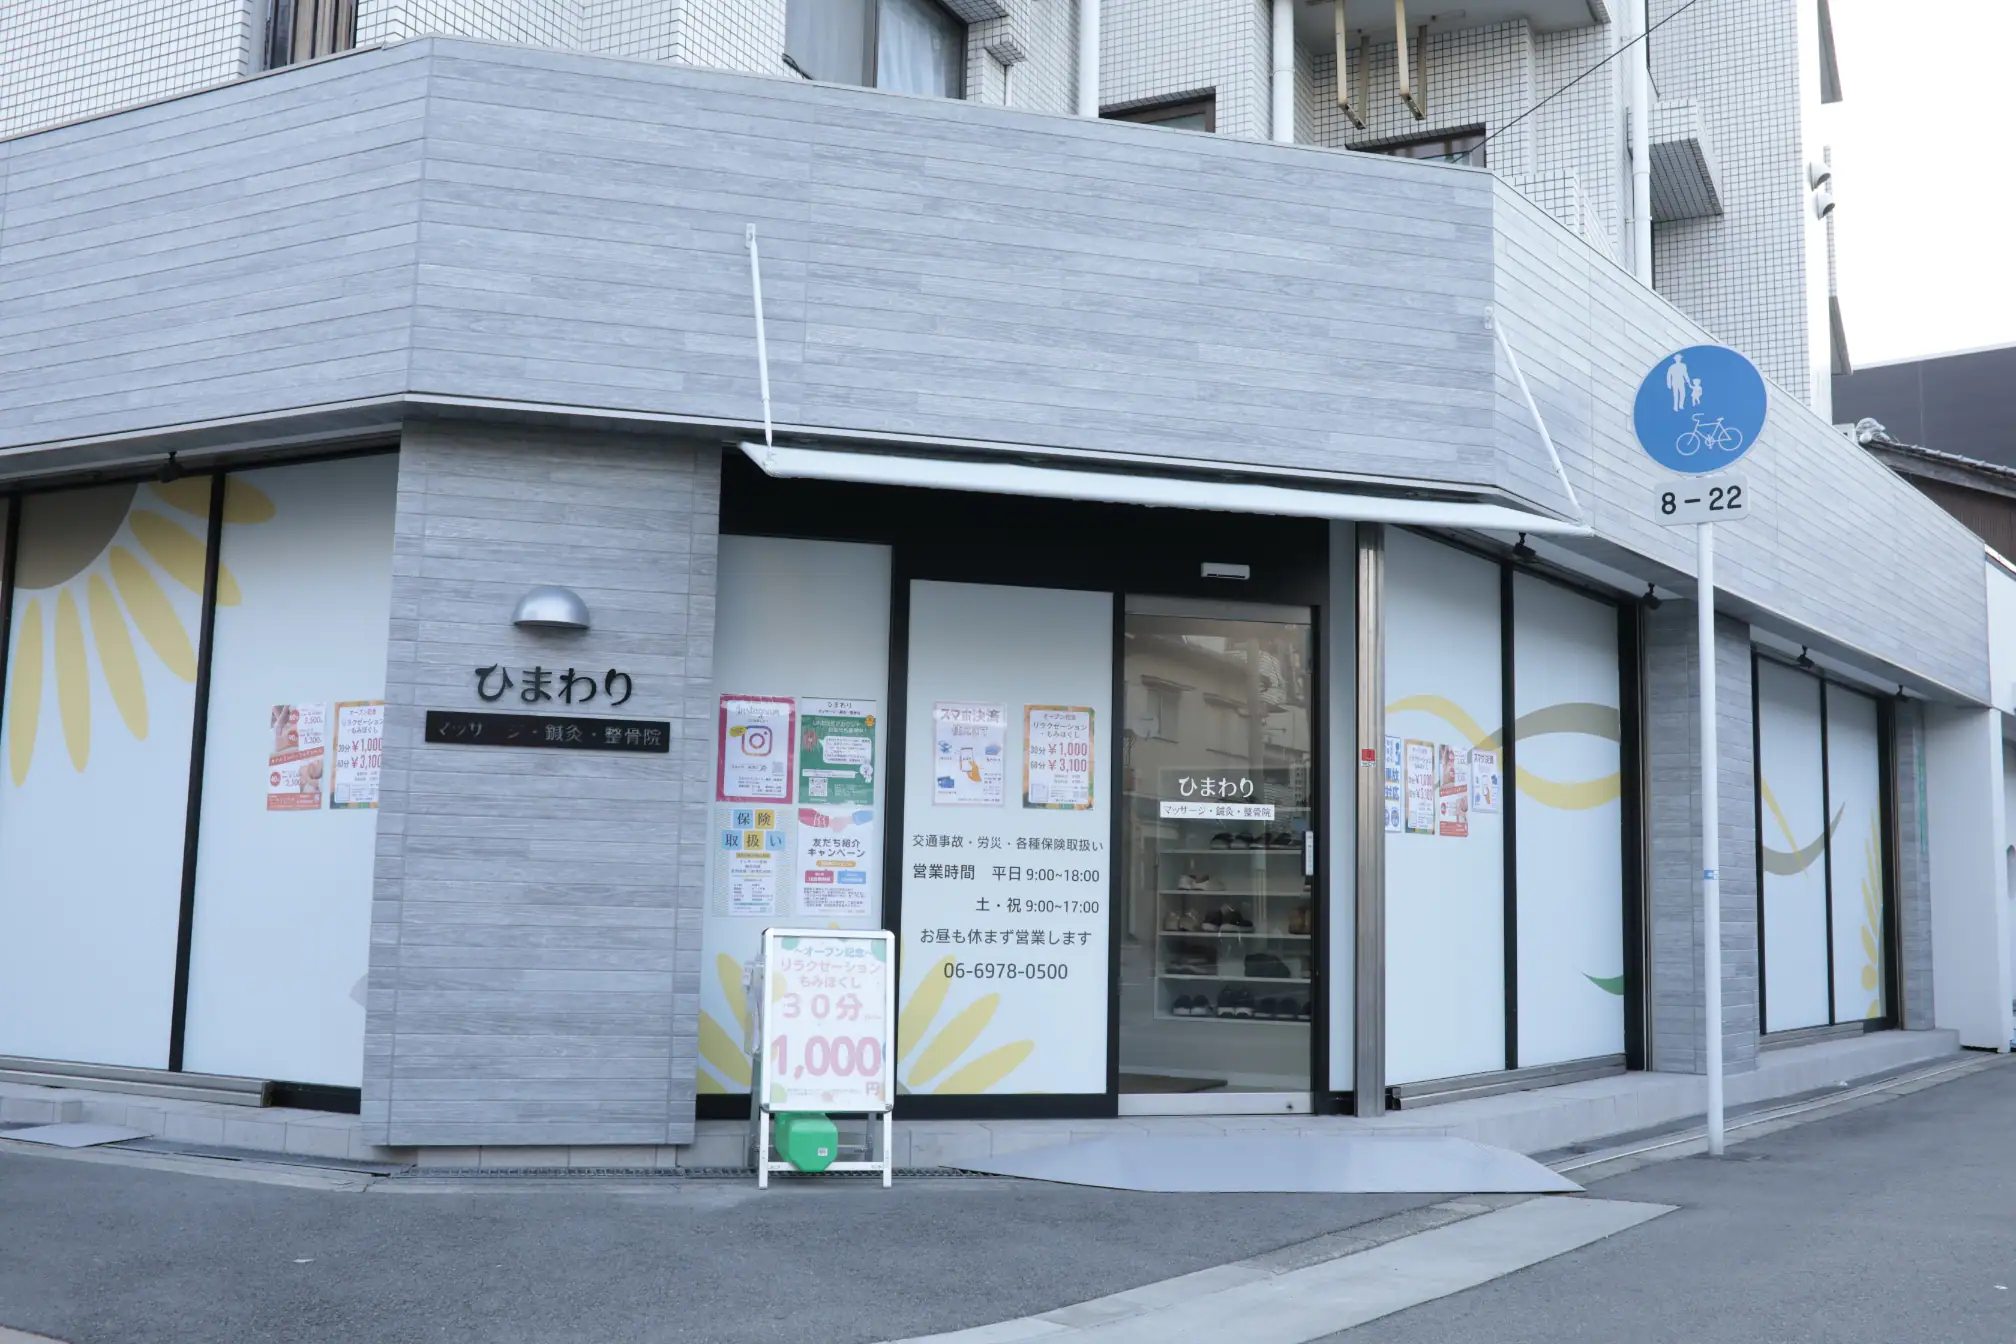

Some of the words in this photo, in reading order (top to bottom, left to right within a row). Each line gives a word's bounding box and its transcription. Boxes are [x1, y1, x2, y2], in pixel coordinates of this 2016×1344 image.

[475, 663, 633, 706] ひまわり
[438, 721, 661, 746] マッサジ・鍼灸・整骨院
[1178, 776, 1254, 798] ひまわり
[737, 812, 771, 826] 保険
[1164, 805, 1272, 818] マッサージ・鍼灸・整骨院
[725, 833, 782, 848] 取扱い
[812, 838, 861, 849] 友だち紹介
[912, 834, 1104, 852] 交通事故・労災・各種保険取扱い
[807, 848, 866, 858] キャンペーン
[913, 863, 975, 881] 営業時間
[991, 865, 1021, 881] 平日
[1026, 868, 1100, 883] 9:00~18:00
[975, 897, 1021, 913] 土・祝
[1025, 899, 1100, 914] 9:00~17:00
[920, 928, 1092, 946] お昼も休まず営業します
[781, 958, 882, 975] リラクゼーション
[943, 962, 1068, 980] 06-6978-0500
[782, 993, 863, 1021] 30分
[771, 1034, 882, 1080] 1,000
[865, 1081, 880, 1096] 円
